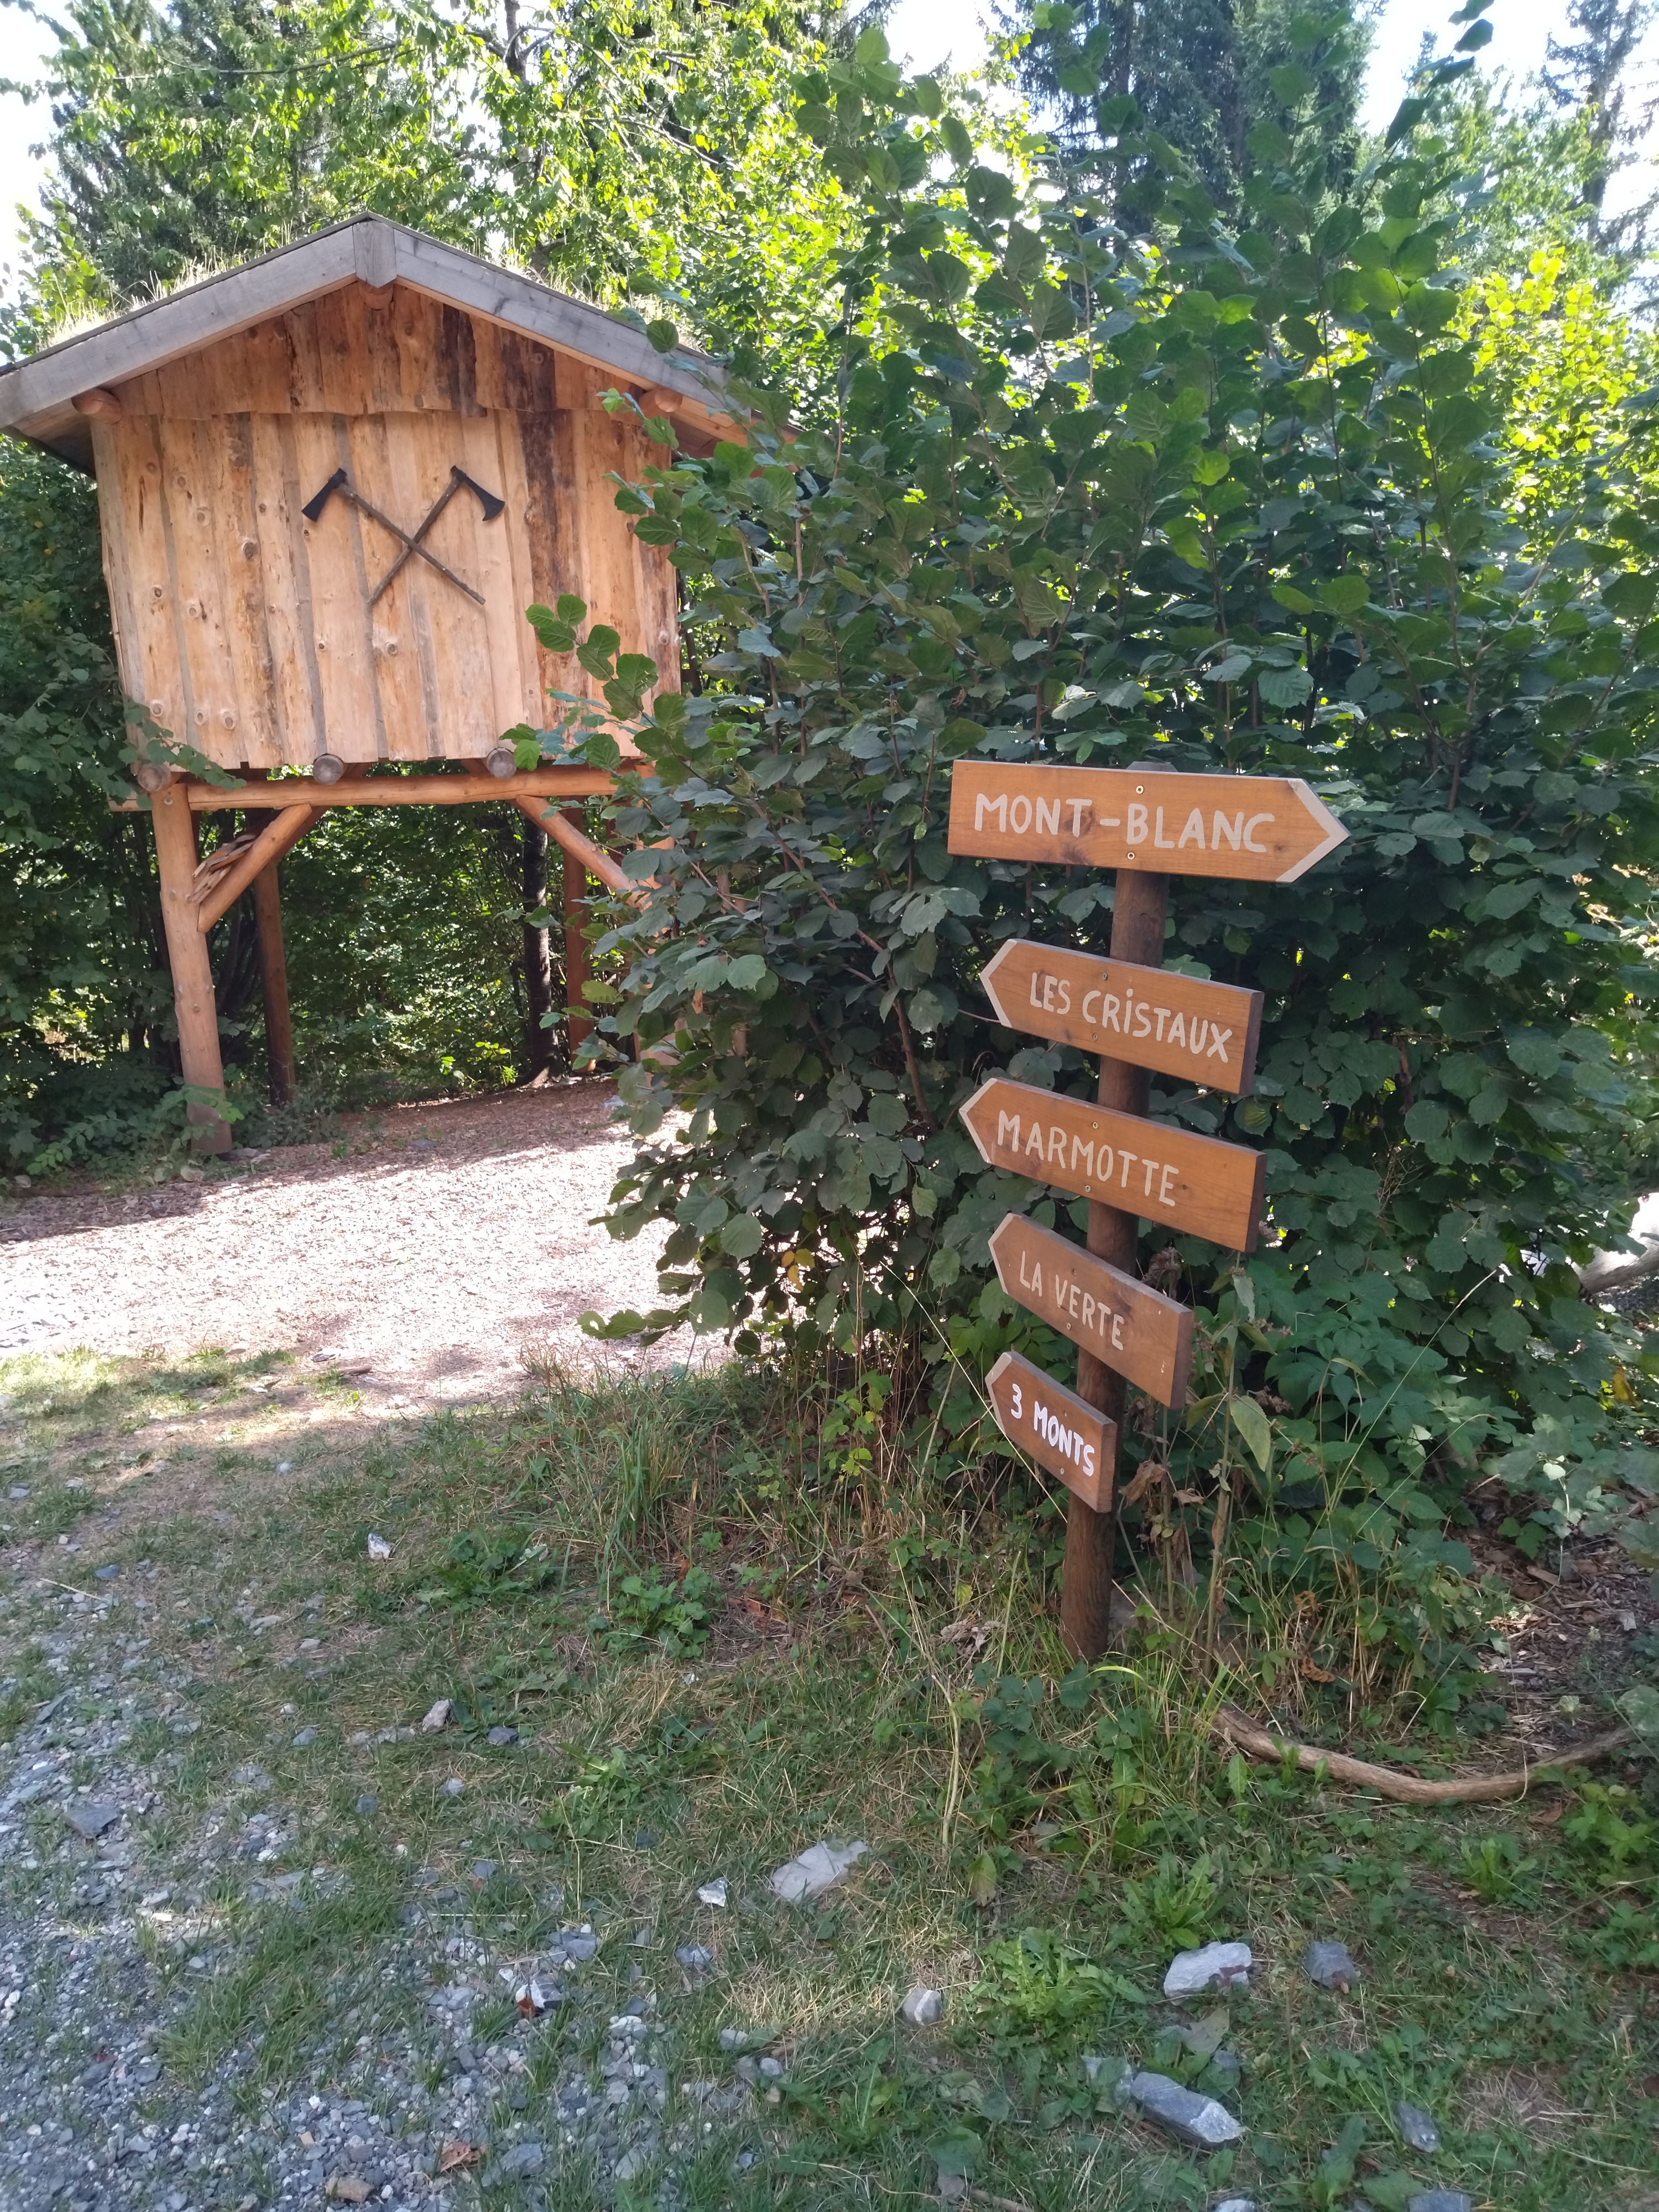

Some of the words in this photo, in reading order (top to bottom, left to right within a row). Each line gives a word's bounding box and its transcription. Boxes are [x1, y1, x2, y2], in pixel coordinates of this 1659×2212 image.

[974, 792, 1275, 853] MONT-BLANC
[1030, 972, 1072, 1015] LES
[997, 1109, 1179, 1207] MARMOTTE
[1019, 1250, 1043, 1297] LA
[1055, 1274, 1125, 1351] VERTE
[1010, 1383, 1022, 1420] 3
[1033, 1401, 1095, 1477] MONTS
